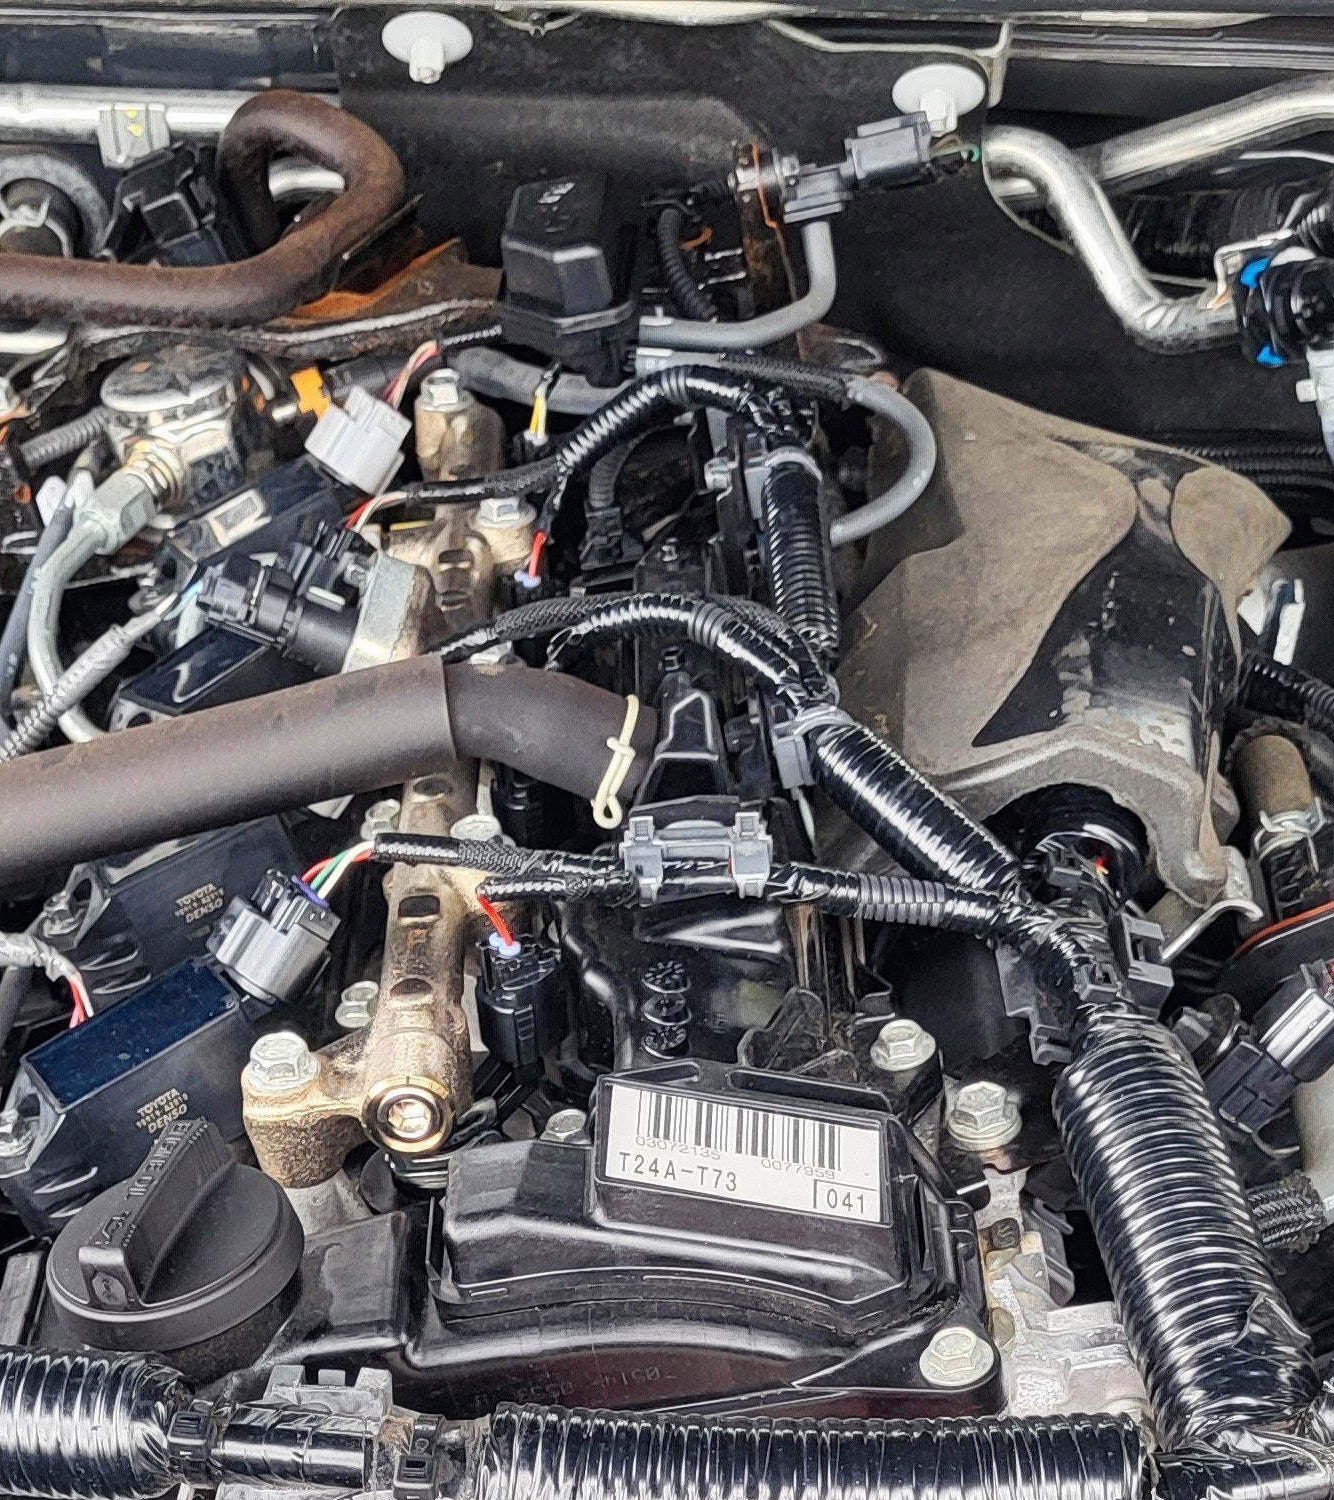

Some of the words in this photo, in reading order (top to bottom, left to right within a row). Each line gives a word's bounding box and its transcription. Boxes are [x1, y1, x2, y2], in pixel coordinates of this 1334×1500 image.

[175, 882, 217, 907] TOYOTA
[136, 1087, 181, 1117] TOYOTA
[147, 1103, 188, 1134] DENSO
[144, 1121, 193, 1173] ENGINE
[634, 1135, 721, 1161] 03072135
[760, 1157, 835, 1180] 0077959
[125, 1175, 154, 1200] OIL
[618, 1151, 738, 1192] T24A-T73
[826, 1189, 866, 1214] 041
